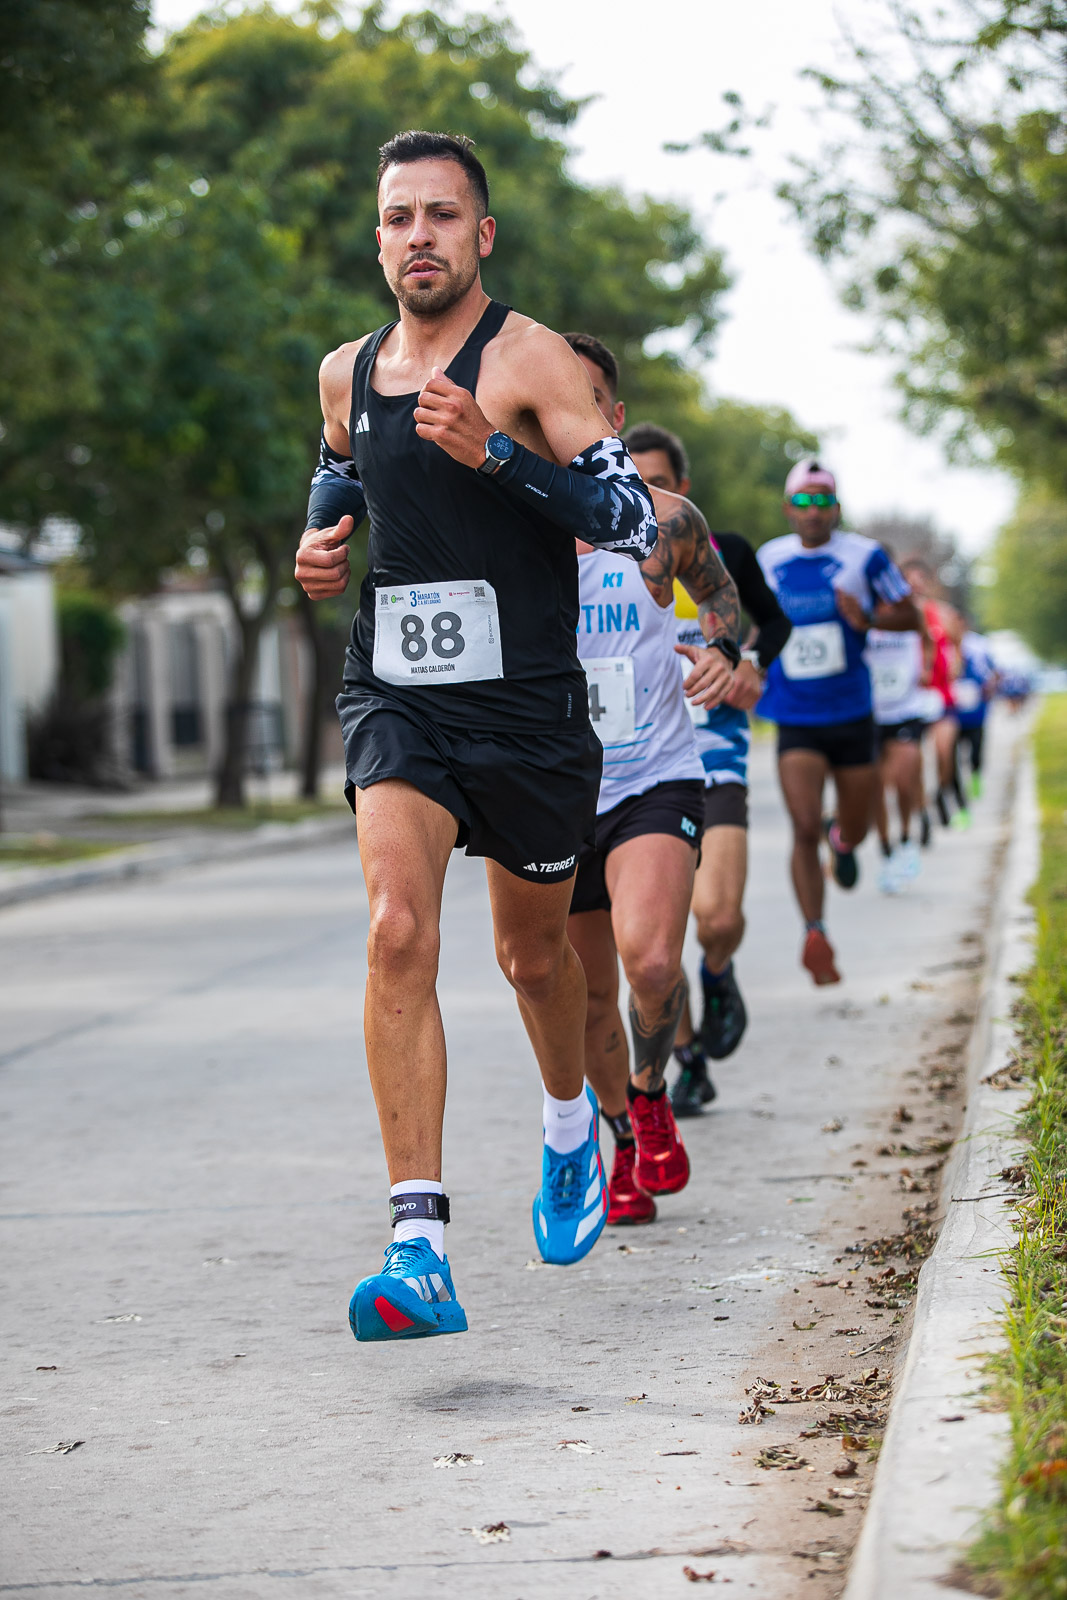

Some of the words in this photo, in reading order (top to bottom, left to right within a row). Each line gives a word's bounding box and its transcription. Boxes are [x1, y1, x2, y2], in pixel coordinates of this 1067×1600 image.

[602, 572, 624, 589] K1
[410, 591, 417, 607] 3
[417, 592, 440, 600] MARATÓN
[576, 603, 640, 633] TINA
[400, 611, 465, 662] 88
[411, 666, 428, 674] MATIAS
[429, 662, 456, 673] CALDERÓN
[539, 854, 576, 873] TERREX
